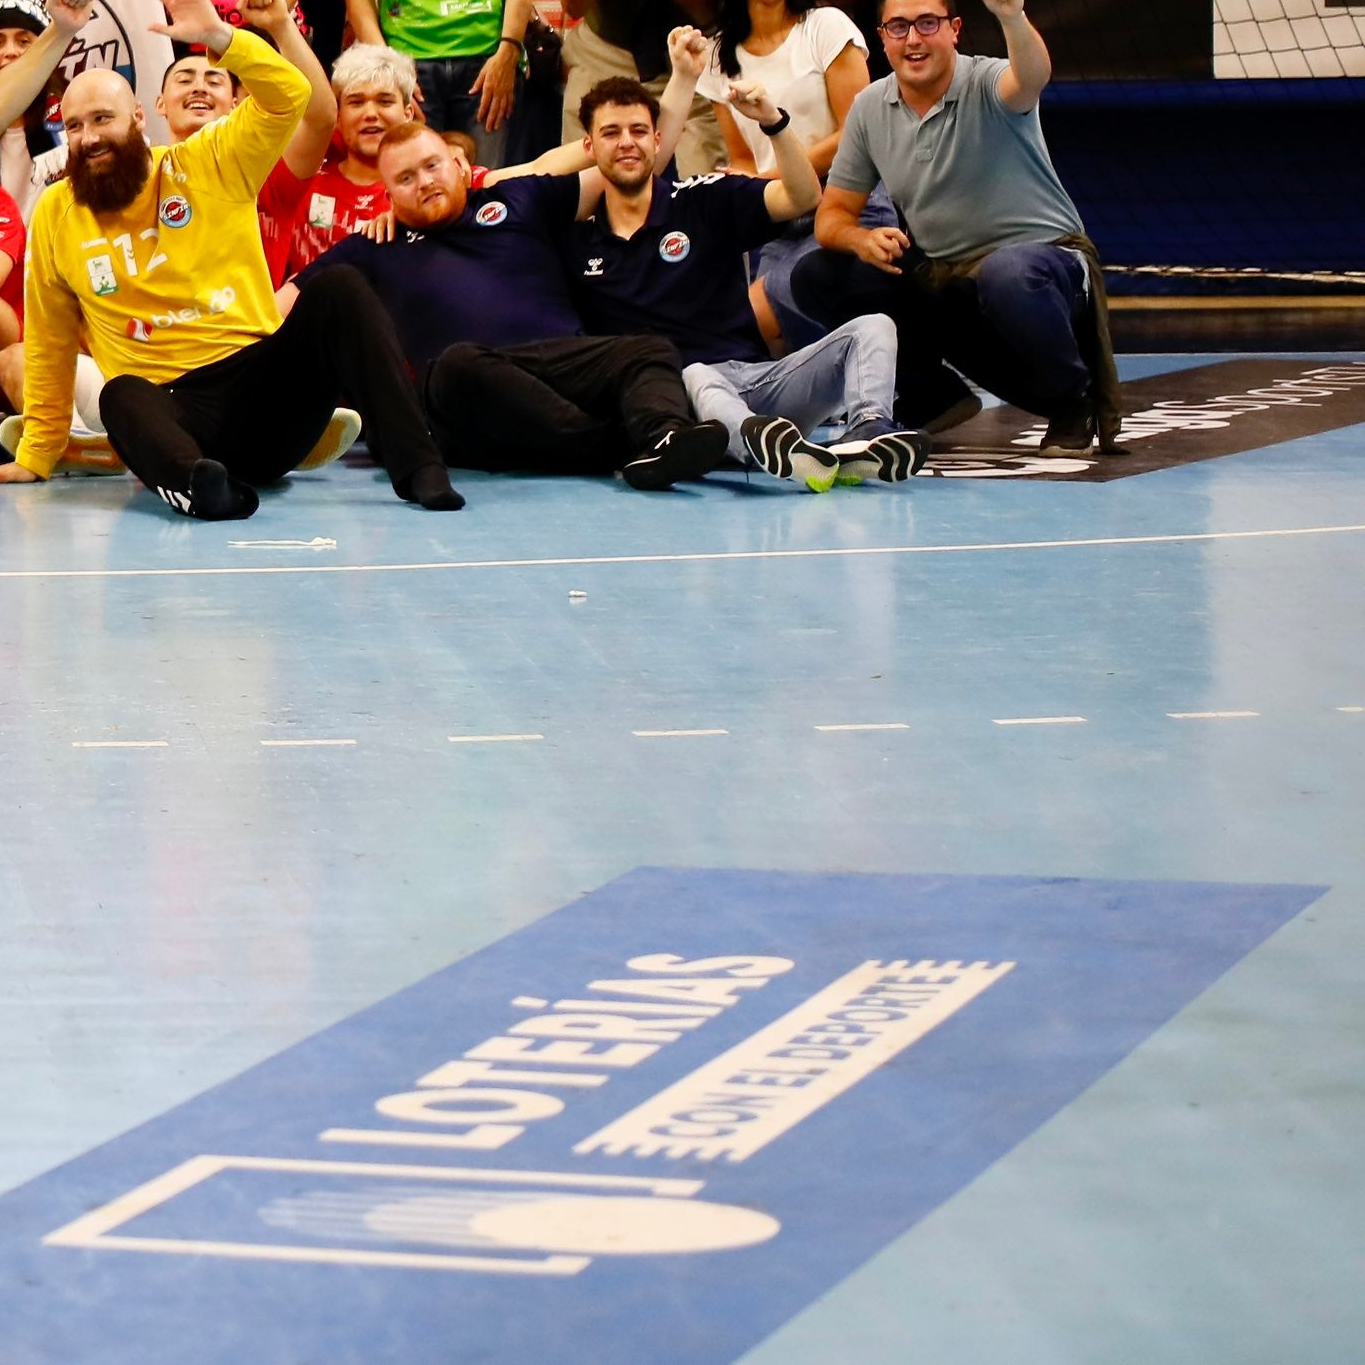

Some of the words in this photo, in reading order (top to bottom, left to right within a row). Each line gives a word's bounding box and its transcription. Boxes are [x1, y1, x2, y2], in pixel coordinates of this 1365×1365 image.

[112, 227, 169, 277] 12
[766, 973, 961, 1062] DEPORTE
[318, 952, 797, 1151] LOTERÍAS
[725, 1065, 827, 1088] EL
[649, 1090, 760, 1139] CON
